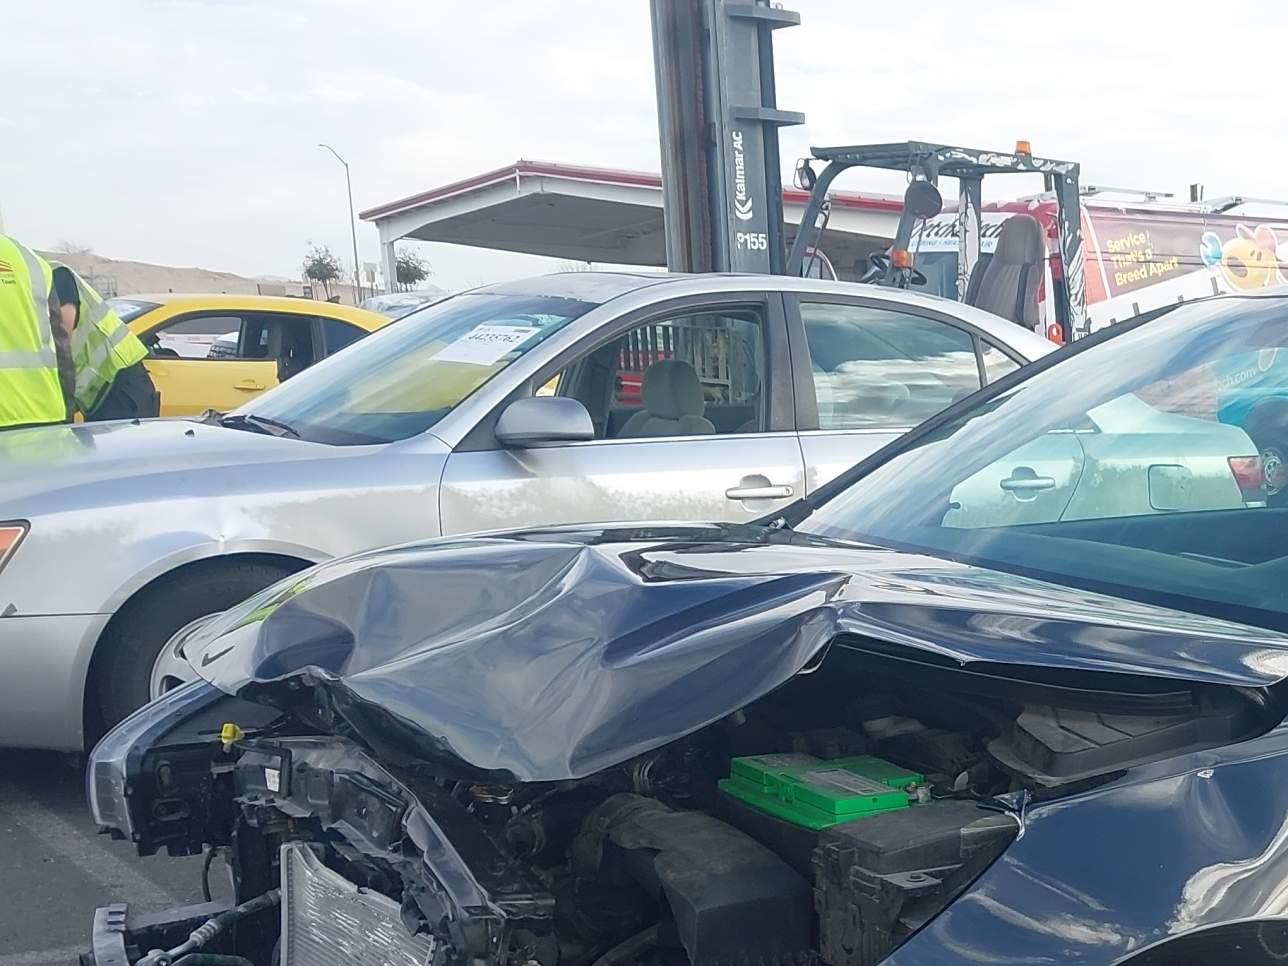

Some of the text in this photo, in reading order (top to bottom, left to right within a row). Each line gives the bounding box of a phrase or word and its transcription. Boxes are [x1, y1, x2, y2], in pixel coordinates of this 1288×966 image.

[732, 131, 746, 200] Kalmar AC
[736, 232, 767, 251] P155
[1114, 255, 1179, 287] Breed Apart
